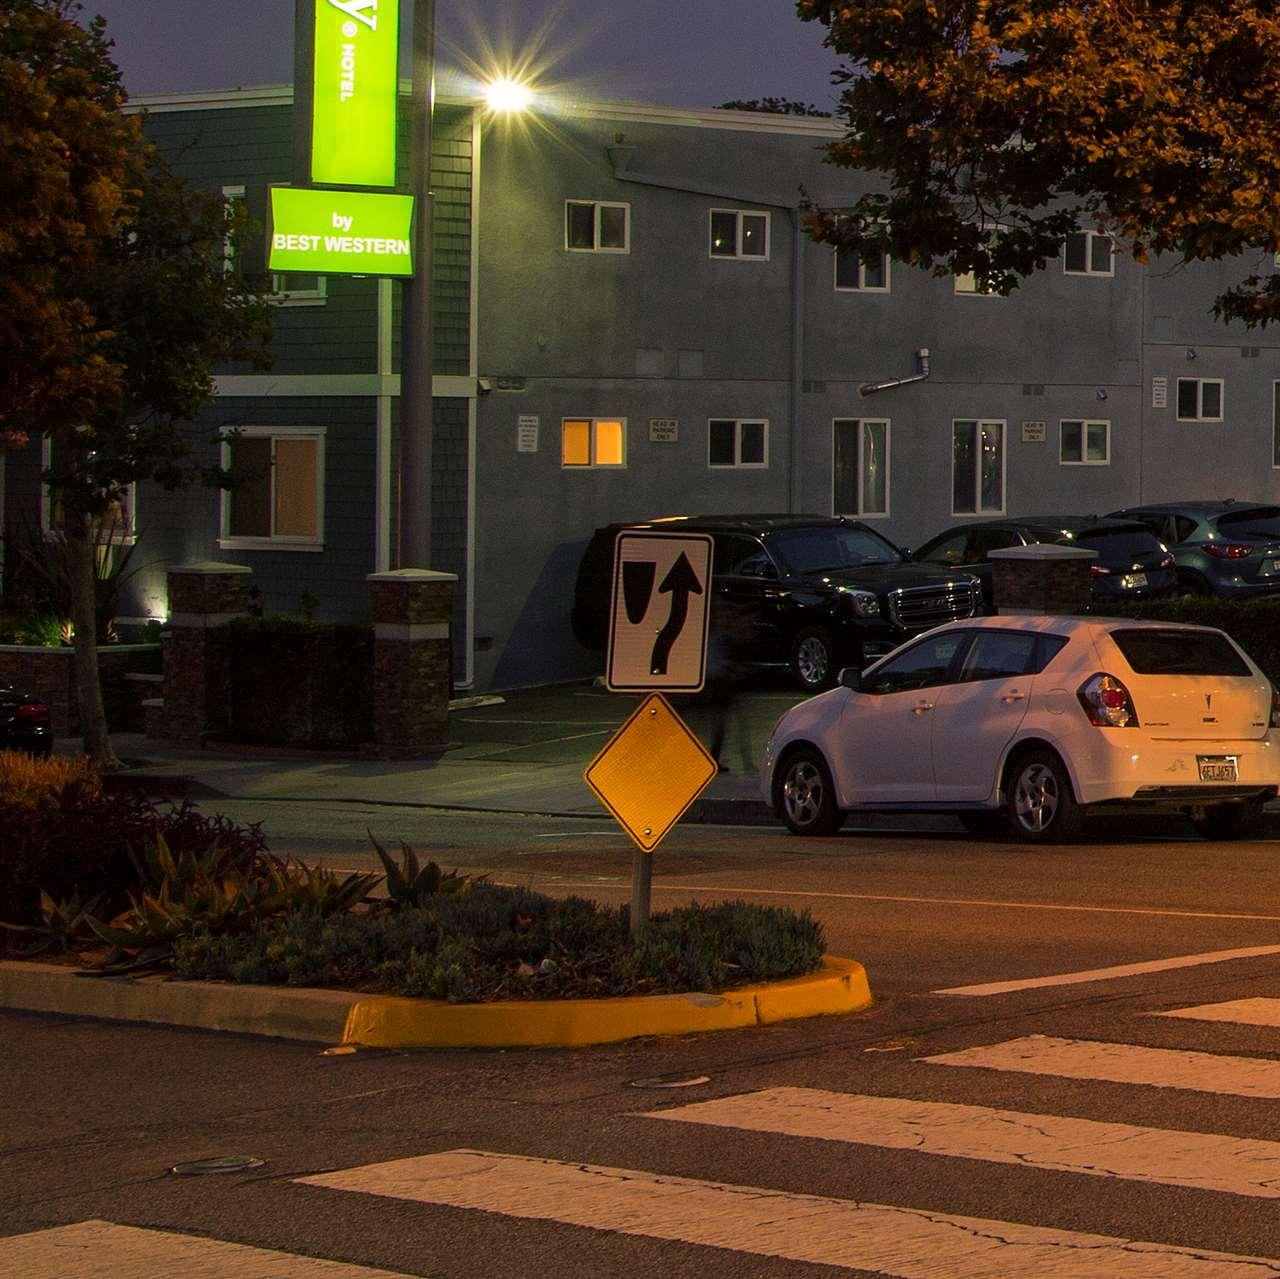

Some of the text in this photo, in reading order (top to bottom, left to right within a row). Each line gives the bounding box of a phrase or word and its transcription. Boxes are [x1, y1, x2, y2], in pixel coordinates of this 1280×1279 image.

[341, 44, 356, 102] HOTEL
[332, 212, 352, 231] by
[274, 234, 409, 256] BEST WESTERN
